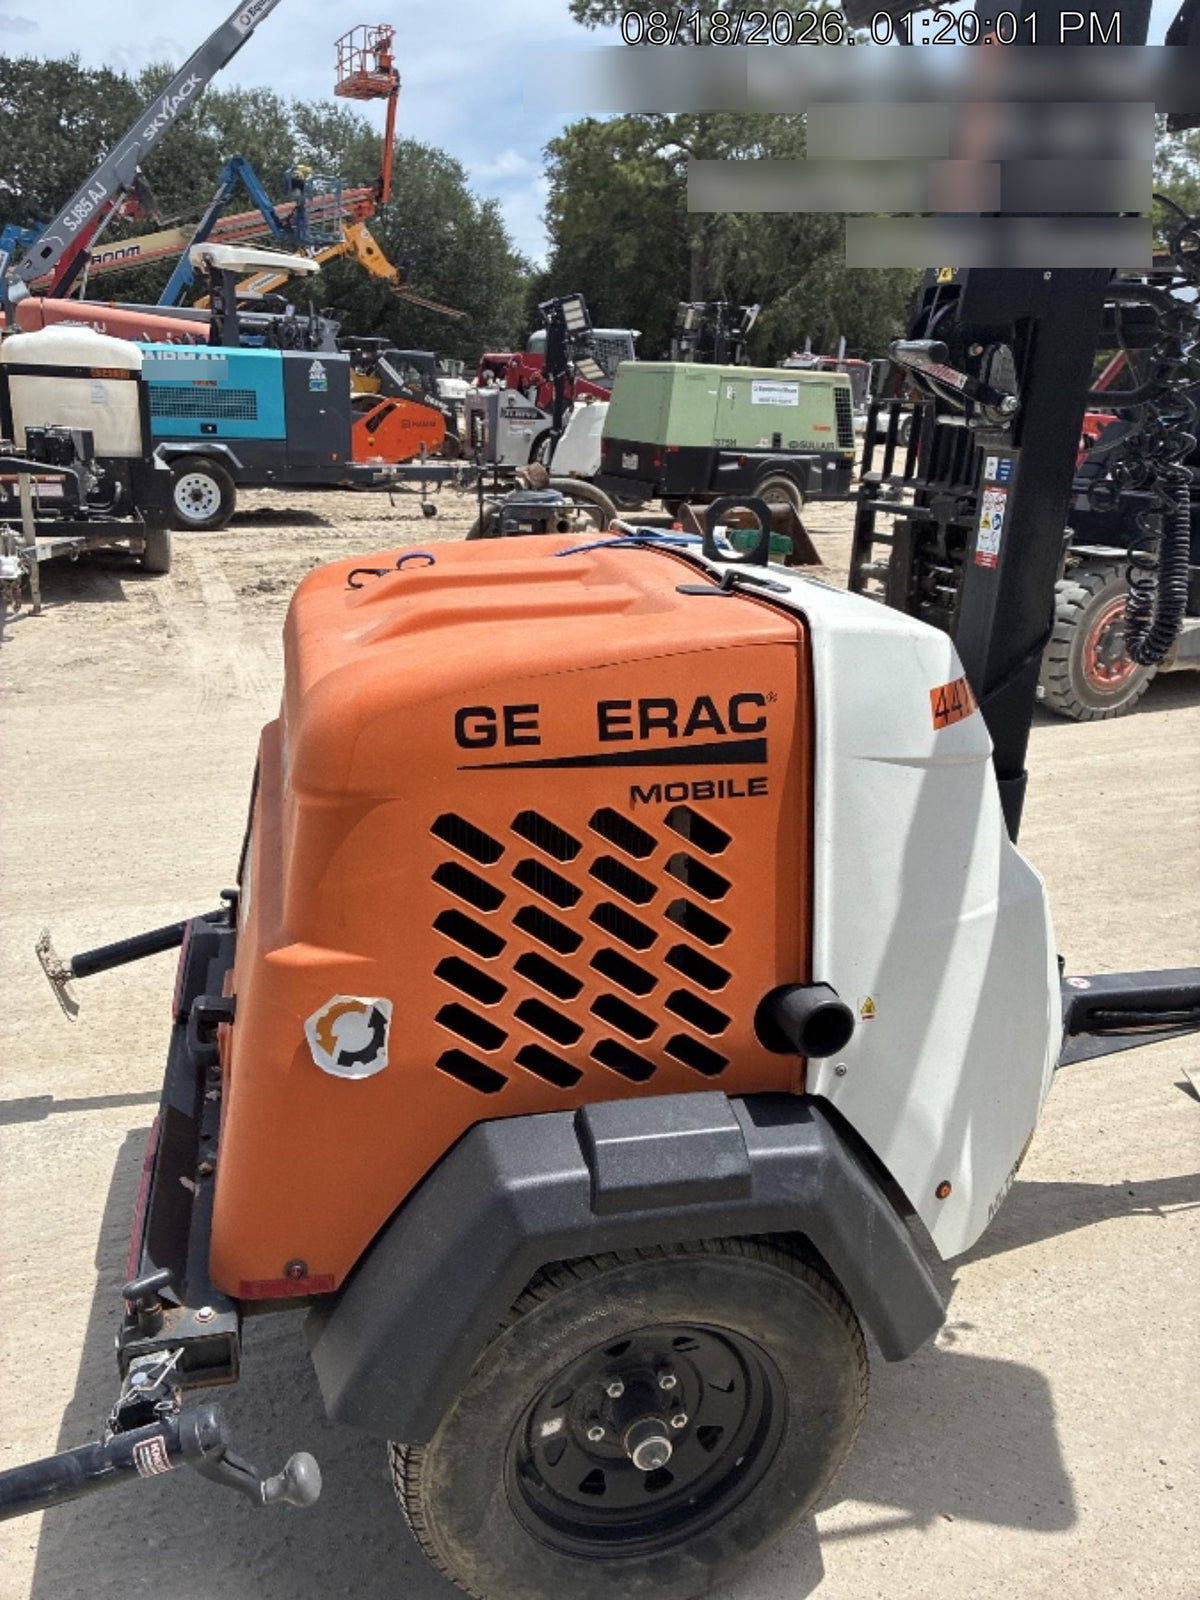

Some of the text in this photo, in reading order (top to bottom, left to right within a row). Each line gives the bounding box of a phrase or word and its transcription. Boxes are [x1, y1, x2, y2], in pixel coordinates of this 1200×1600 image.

[142, 73, 203, 141] SKYJACK
[63, 181, 107, 232] SJ85 AJ
[629, 777, 768, 804] MOBILE
